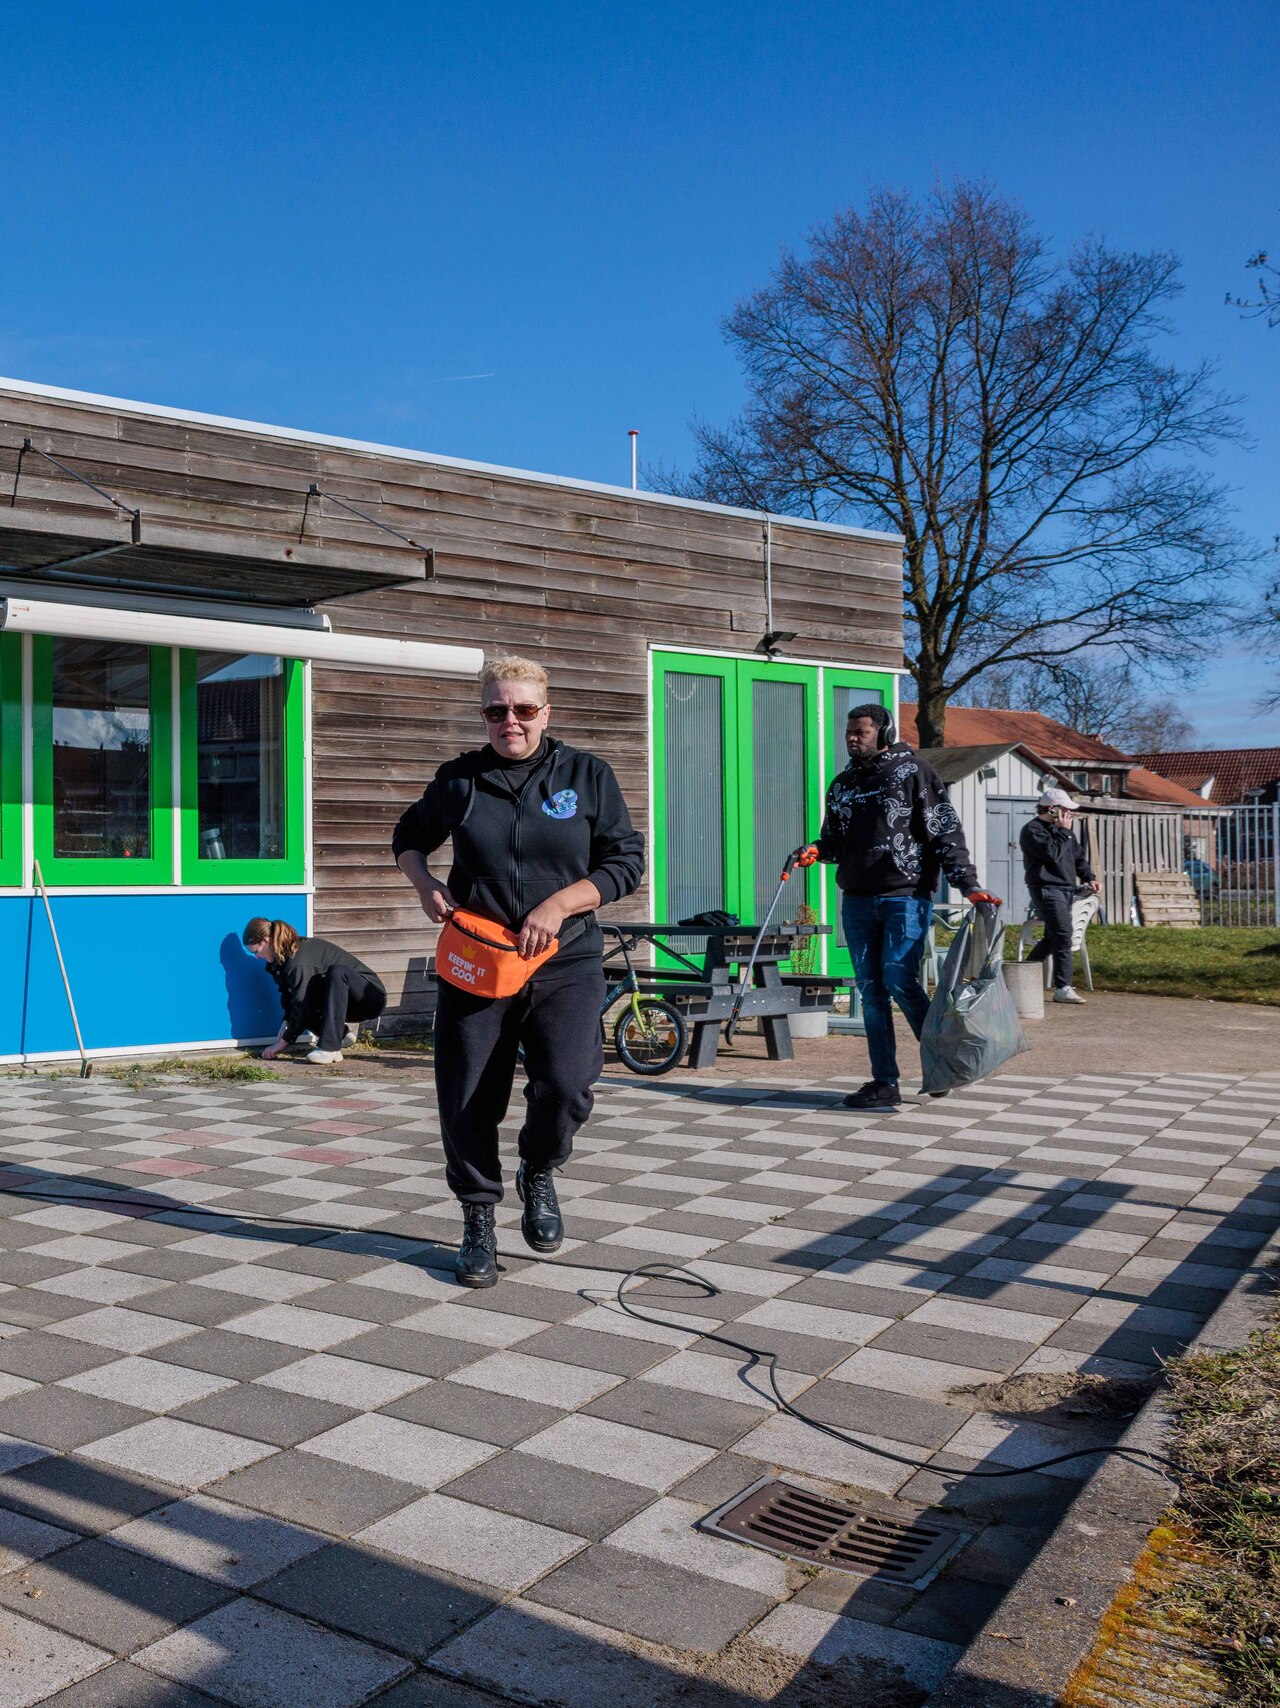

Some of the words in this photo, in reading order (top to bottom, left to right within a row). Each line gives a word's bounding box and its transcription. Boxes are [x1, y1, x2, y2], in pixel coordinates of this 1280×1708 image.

[448, 952, 475, 972] KEEPIN'
[477, 967, 486, 976] IT
[451, 966, 475, 984] COOL
